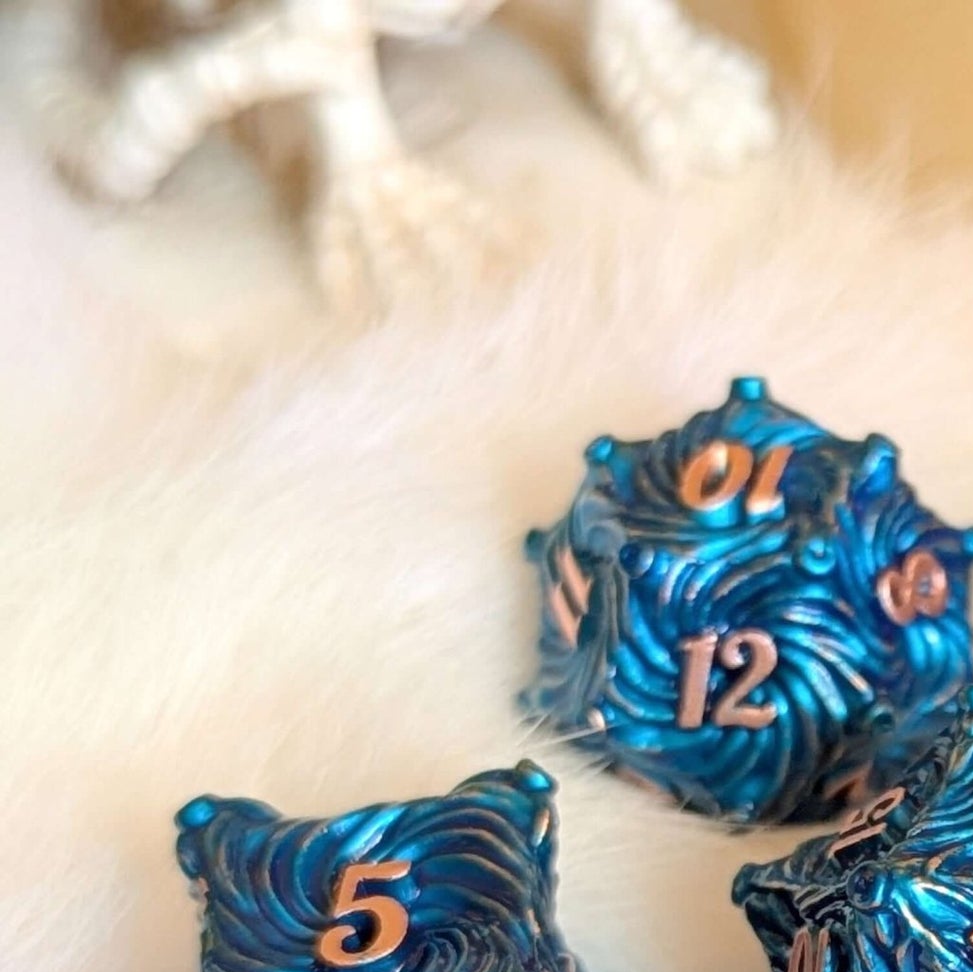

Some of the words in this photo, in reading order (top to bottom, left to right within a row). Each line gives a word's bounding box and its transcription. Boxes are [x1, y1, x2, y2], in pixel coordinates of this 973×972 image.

[877, 549, 949, 627] 8
[677, 629, 779, 730] 12
[318, 860, 413, 968] 5
